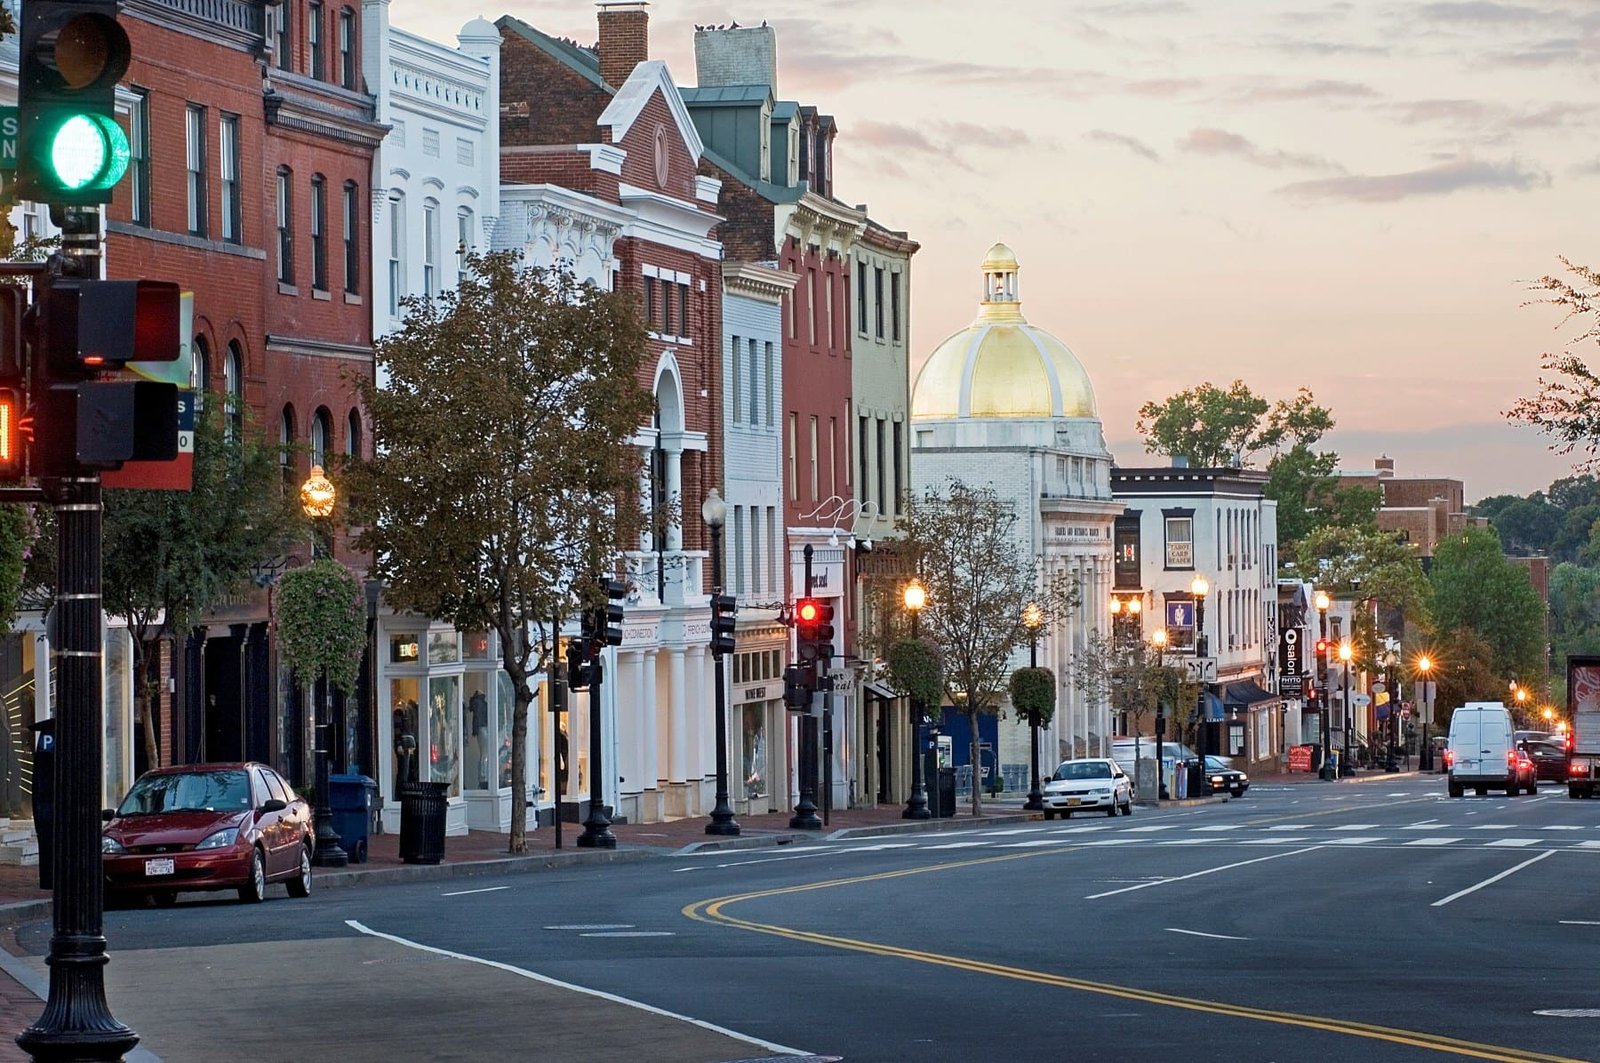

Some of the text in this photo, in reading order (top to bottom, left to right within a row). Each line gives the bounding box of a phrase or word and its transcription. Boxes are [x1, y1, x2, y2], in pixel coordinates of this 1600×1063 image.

[833, 680, 851, 690] eal
[43, 734, 54, 750] P
[929, 741, 935, 749] P
